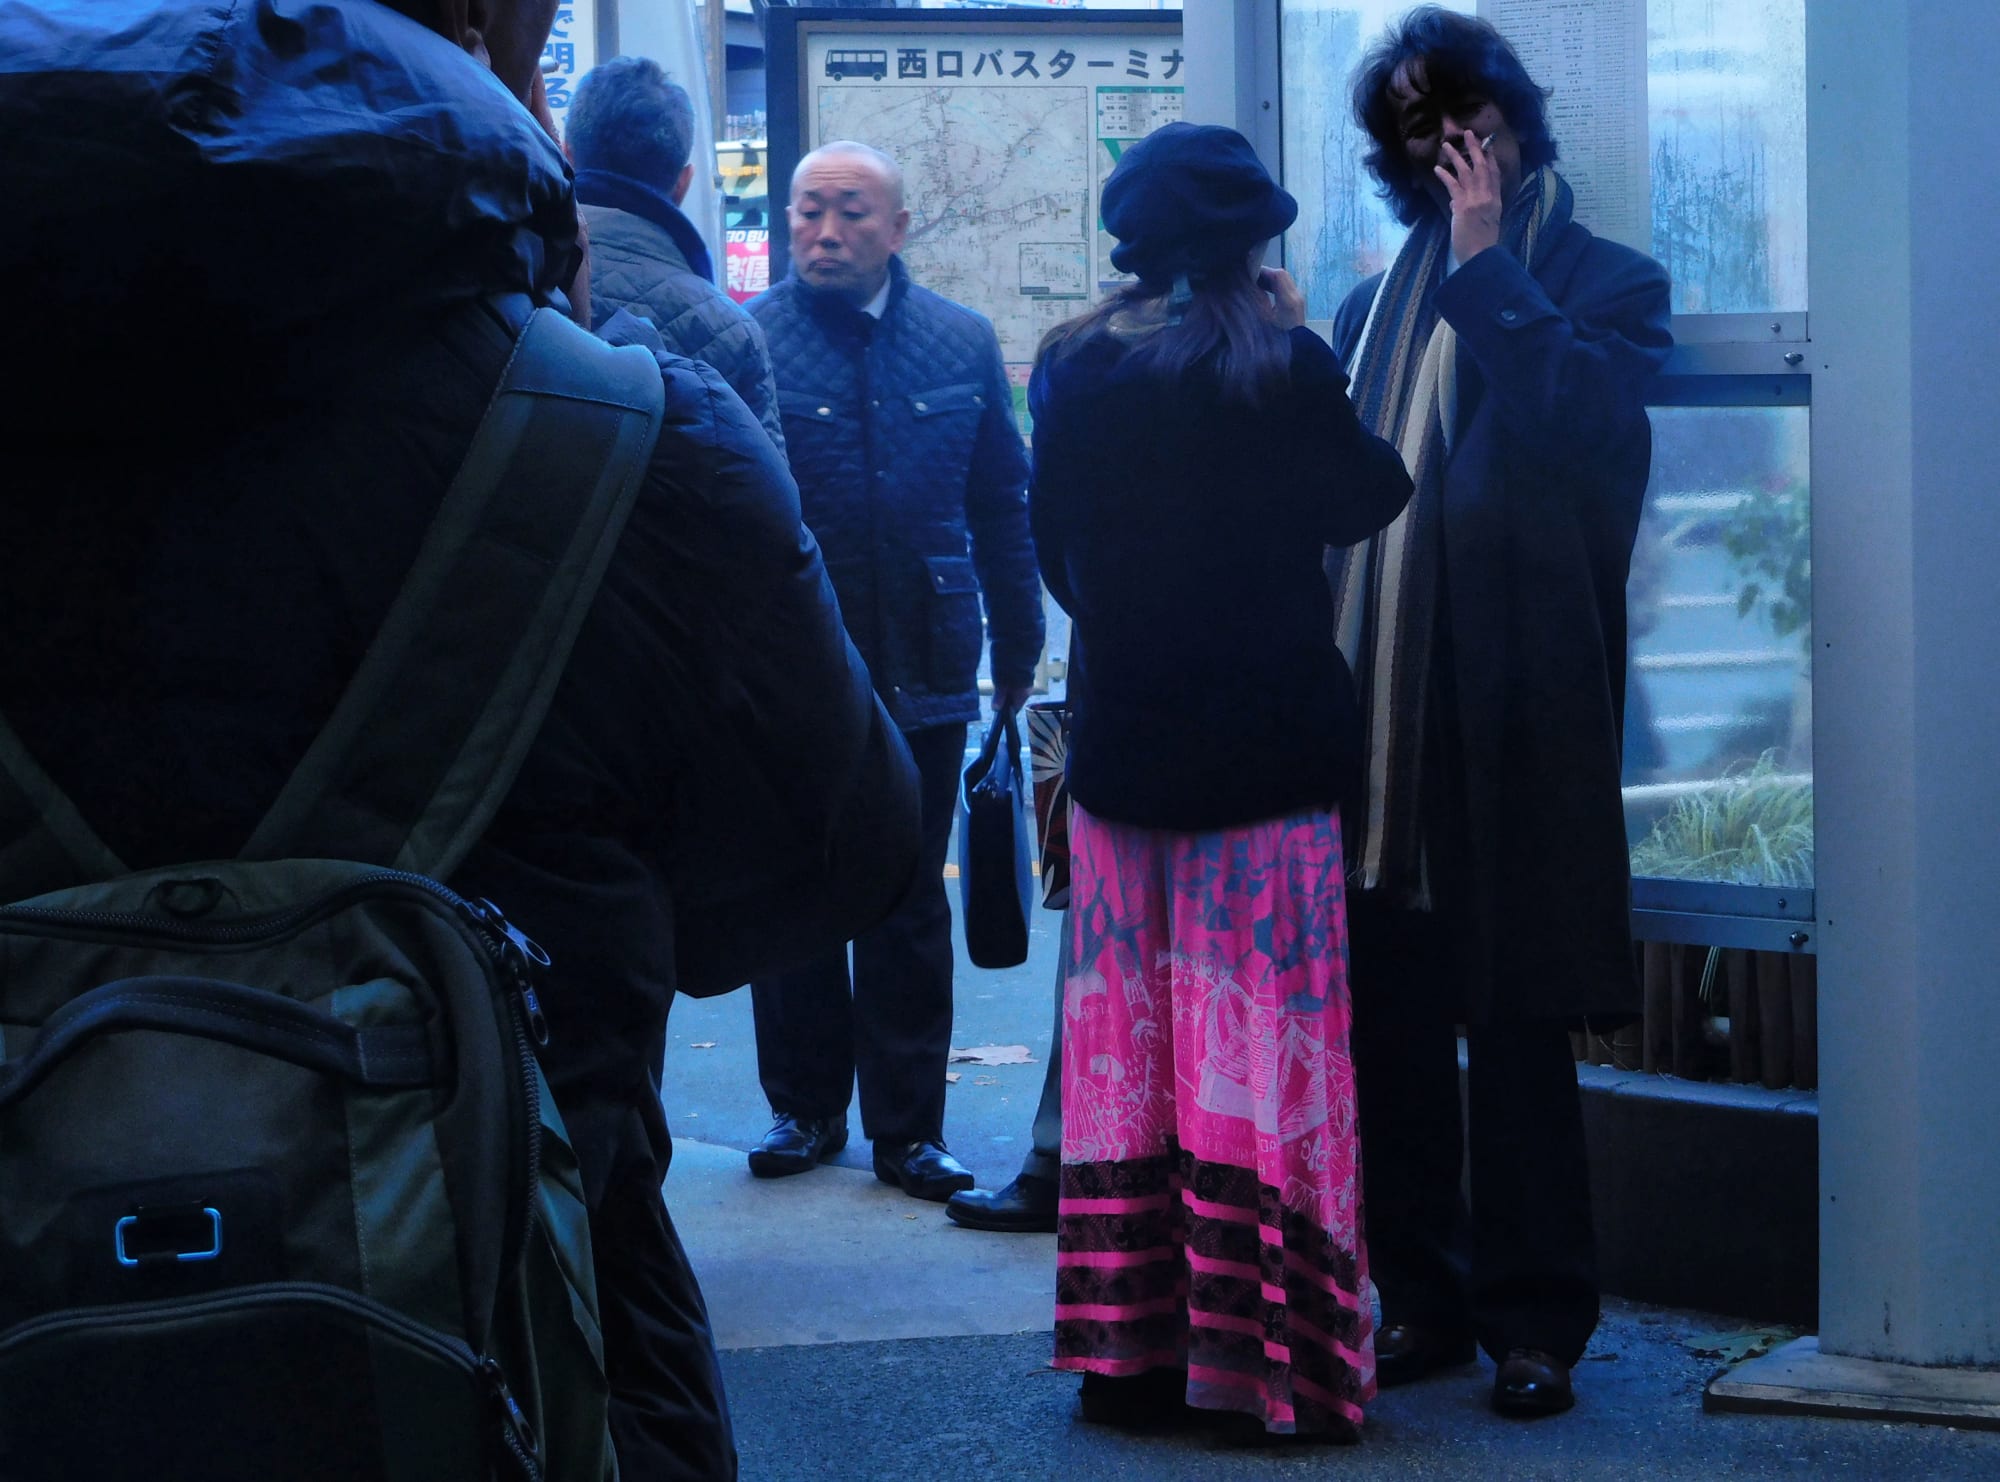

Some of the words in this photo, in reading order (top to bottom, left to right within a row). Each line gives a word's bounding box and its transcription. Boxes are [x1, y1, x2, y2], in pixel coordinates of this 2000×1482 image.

[897, 48, 1184, 80] 西口バスターミナ
